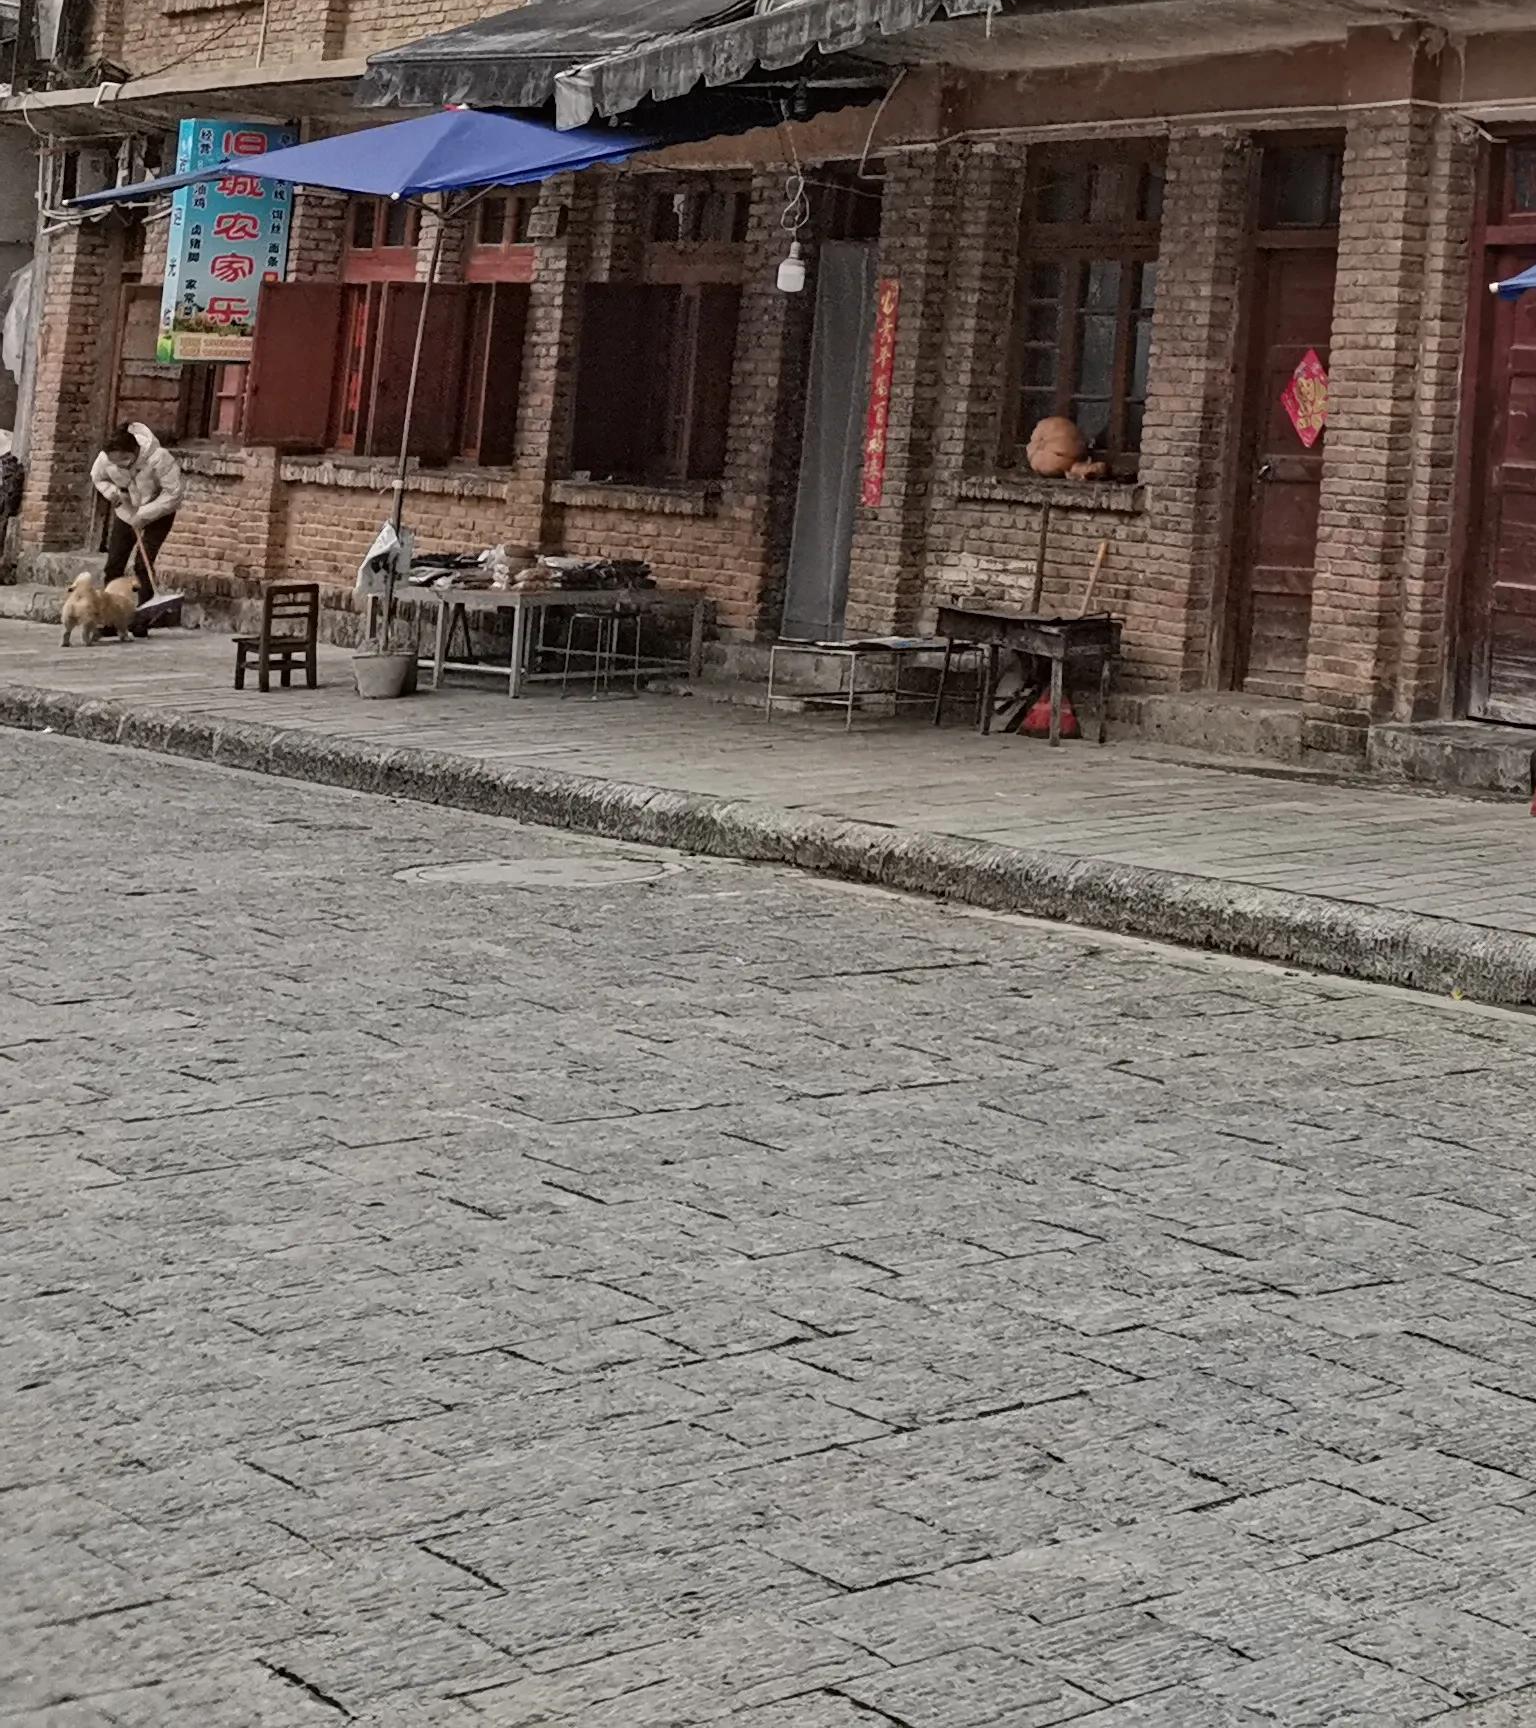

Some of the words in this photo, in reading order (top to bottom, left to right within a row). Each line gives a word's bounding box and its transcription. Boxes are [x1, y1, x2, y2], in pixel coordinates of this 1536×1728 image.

[205, 130, 268, 326] 旧城农家乐
